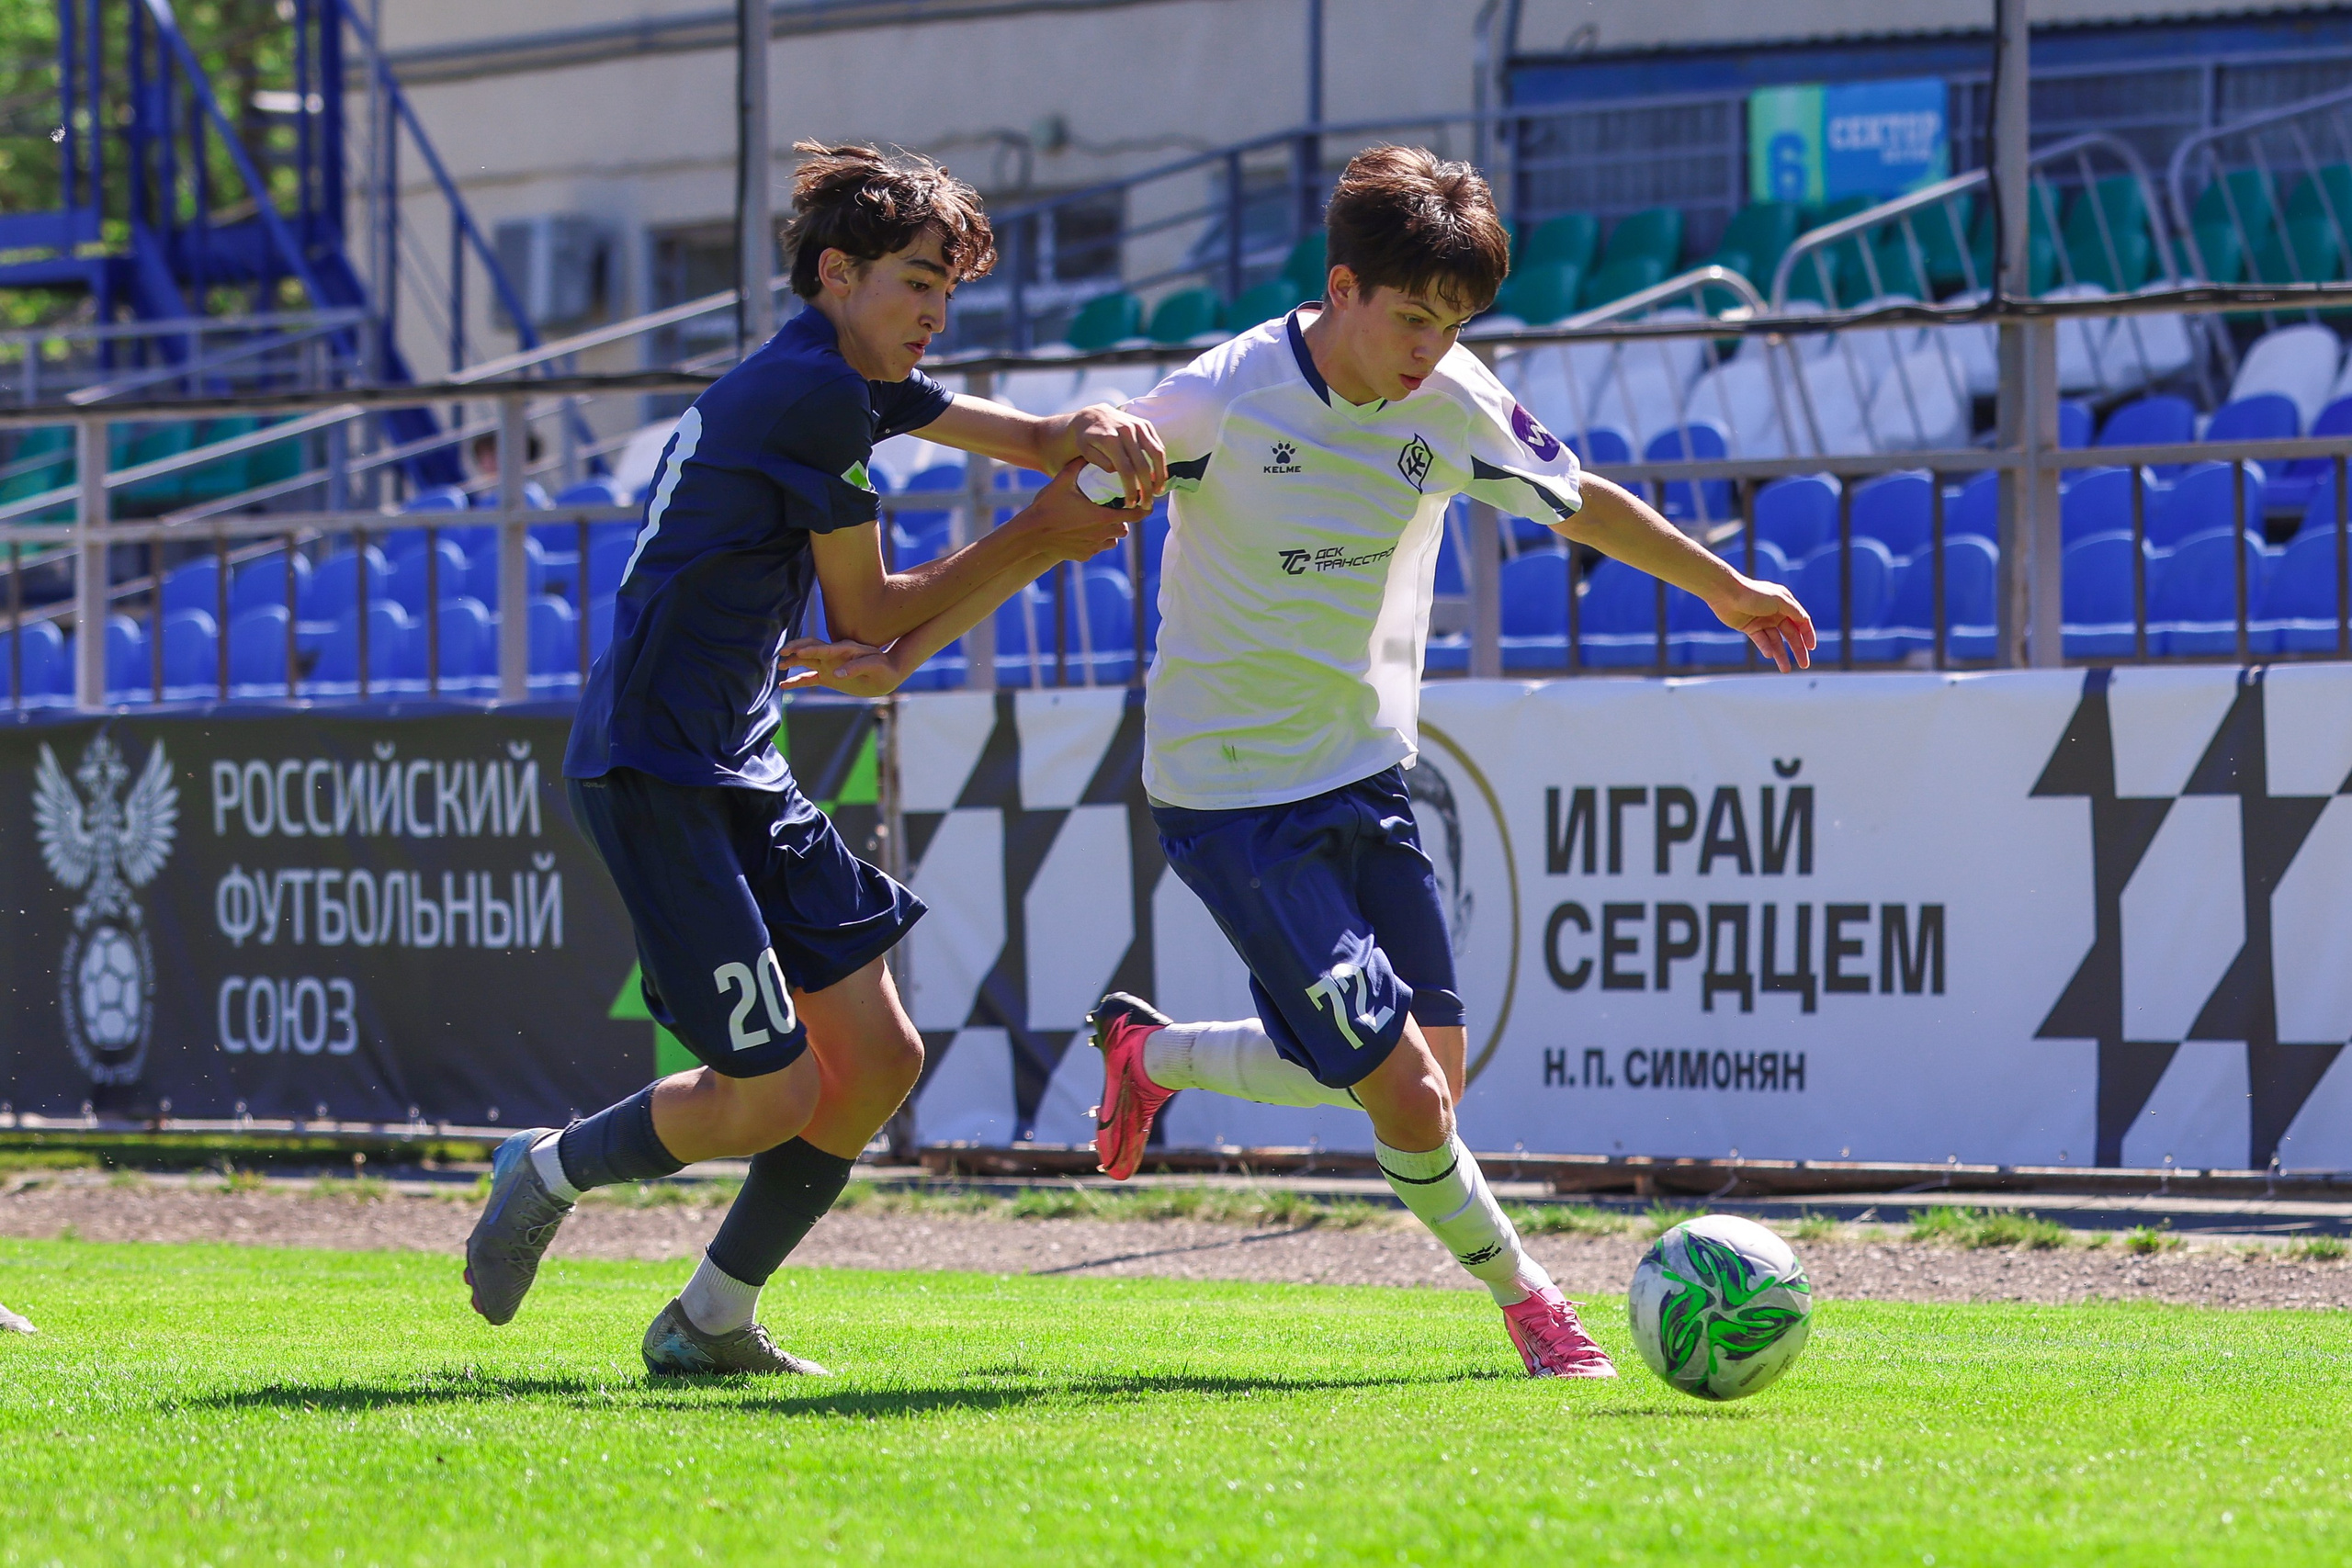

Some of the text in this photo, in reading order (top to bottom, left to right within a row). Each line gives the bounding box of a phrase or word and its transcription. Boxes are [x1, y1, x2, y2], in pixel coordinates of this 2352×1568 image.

[1768, 130, 1806, 201] 6
[1263, 466, 1302, 474] KELME
[1315, 546, 1345, 560] ДСК
[1315, 540, 1399, 572] ТРАНССТРО
[211, 741, 542, 838] РОССИЙСКИЙ
[1544, 758, 1815, 876] ИГРАЙ
[216, 852, 563, 949] ФУТБОЛЬНЫЙ
[713, 946, 797, 1052] 20
[1544, 901, 1947, 1015] СЕРДЦЕМ
[218, 976, 357, 1055] СОЮЗ
[1305, 962, 1396, 1050] 72
[1624, 1049, 1806, 1092] СИМОНЯН
